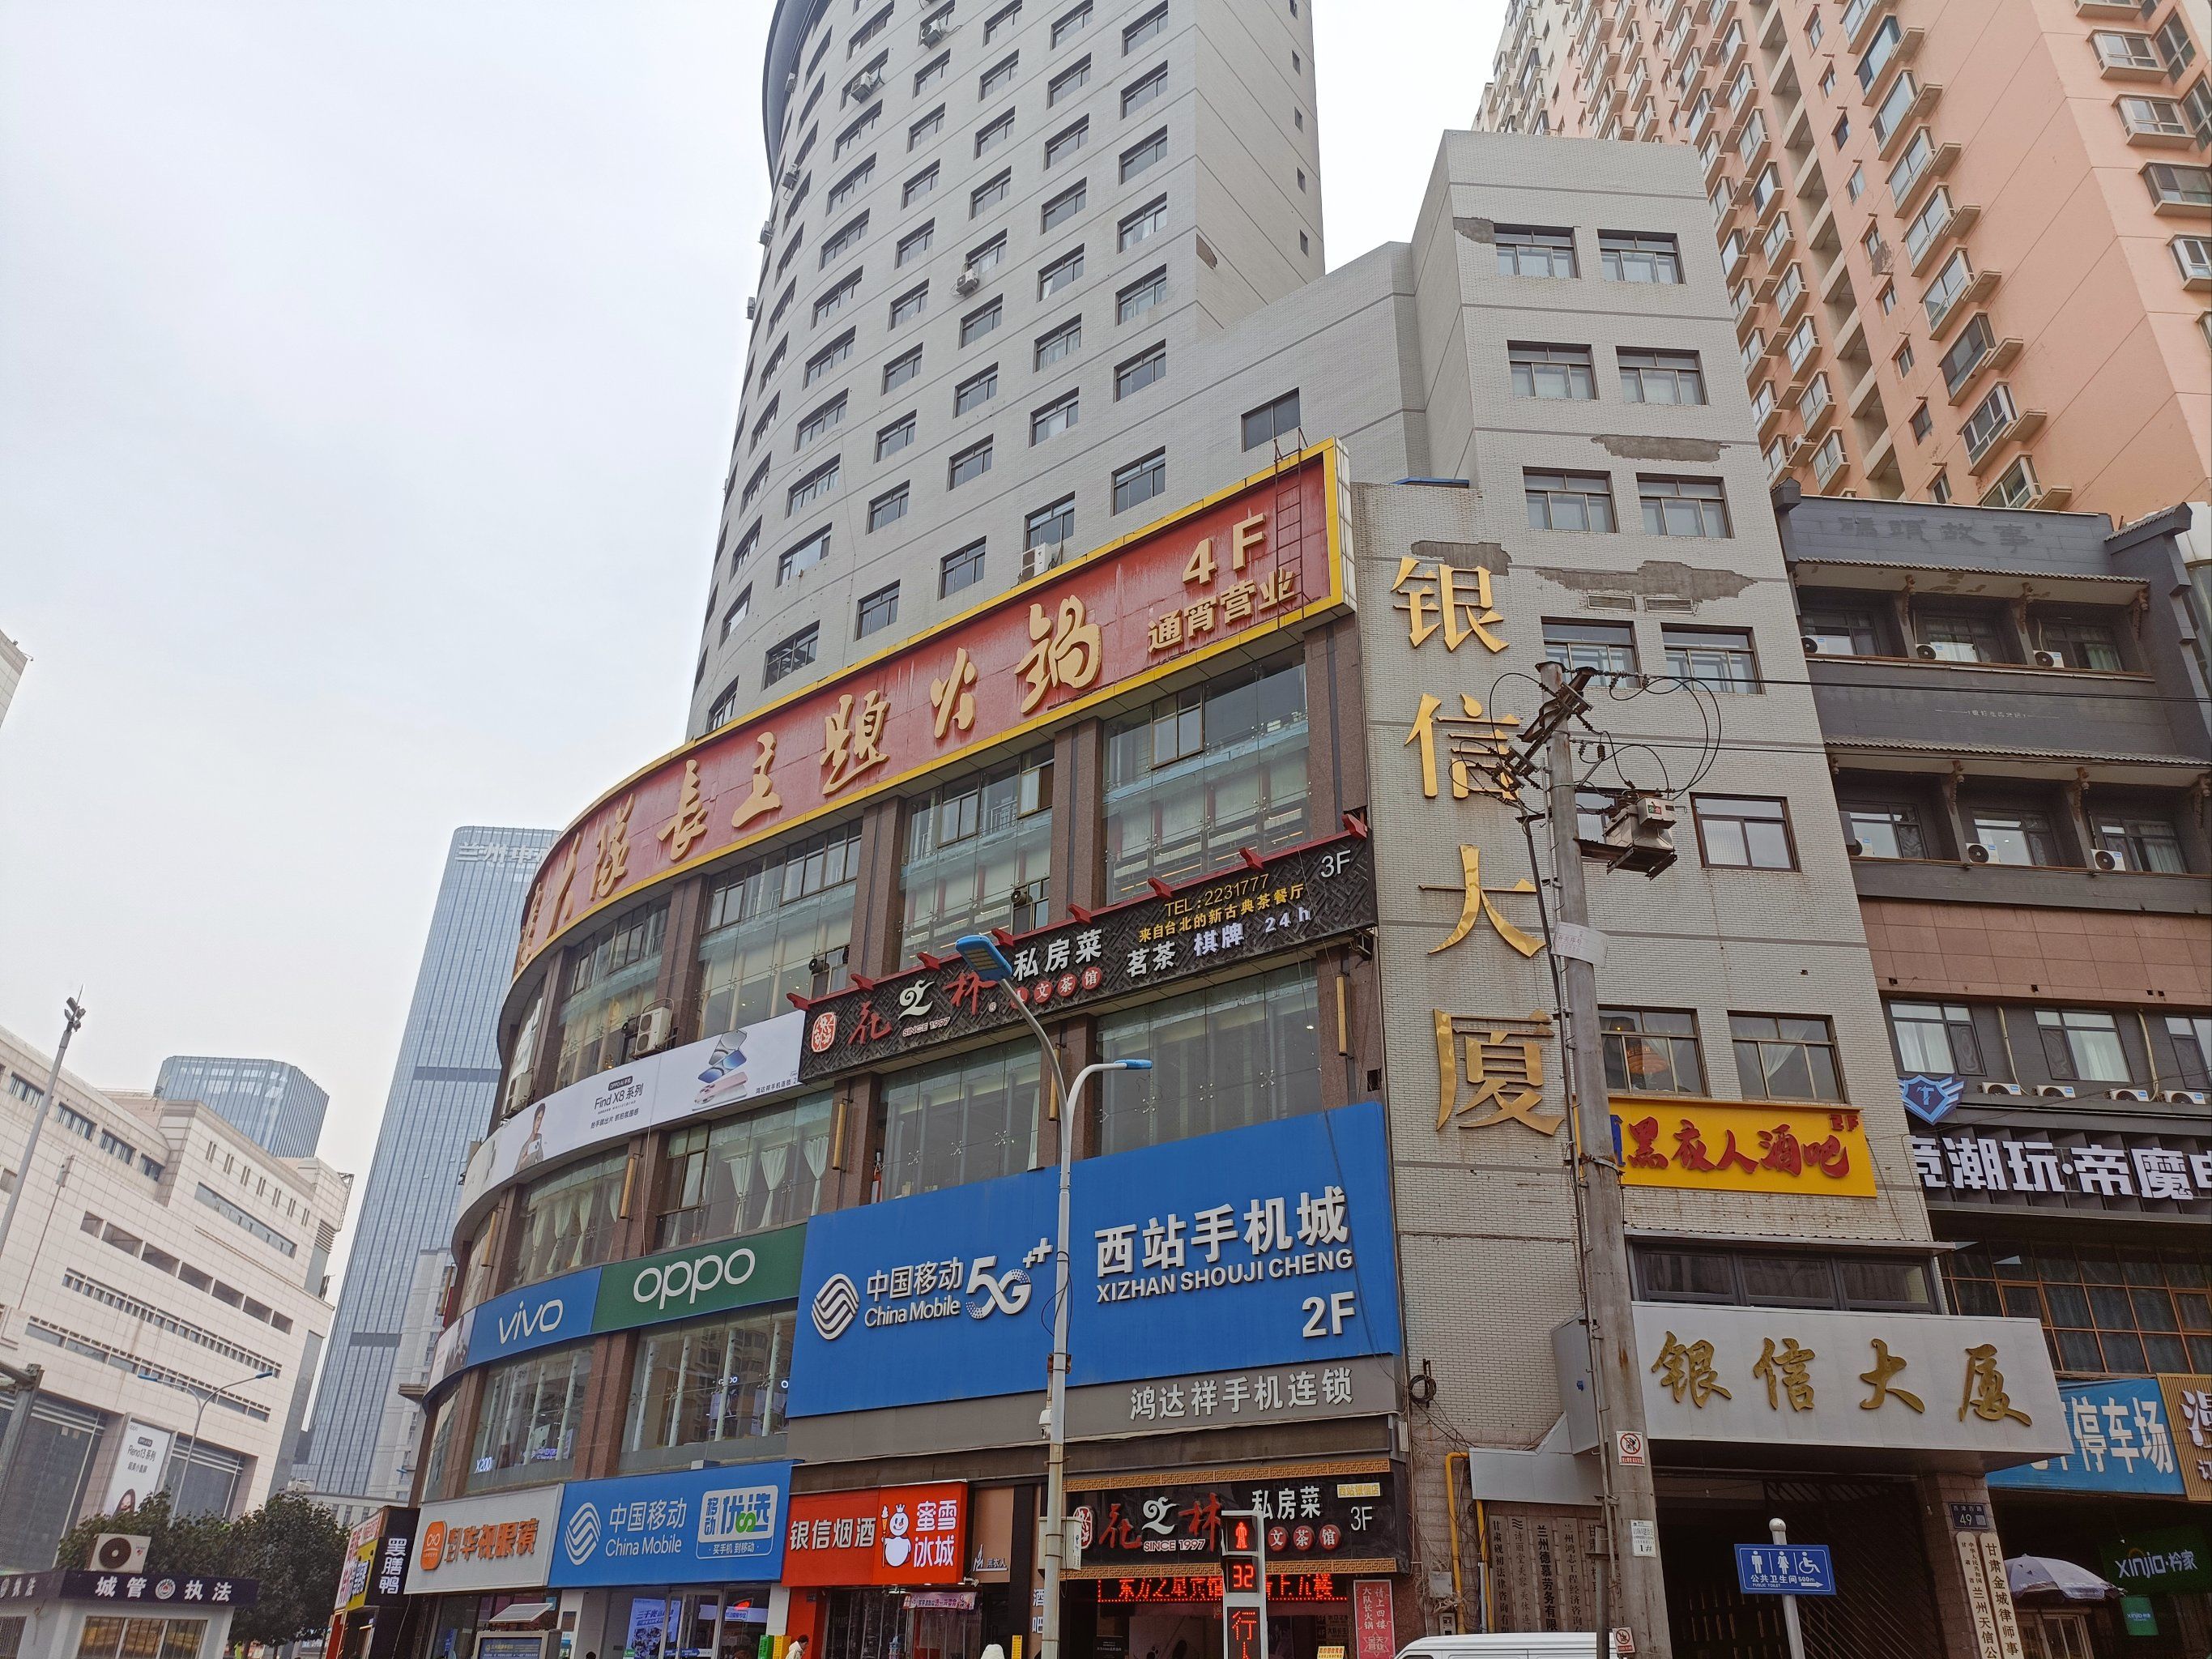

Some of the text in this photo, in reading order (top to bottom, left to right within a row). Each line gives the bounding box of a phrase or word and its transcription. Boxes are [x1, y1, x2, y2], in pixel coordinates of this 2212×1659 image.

[1182, 512, 1268, 586] 4F
[1147, 566, 1298, 655] 通宵营业
[454, 842, 550, 864] 兰州中
[1320, 849, 1352, 878] 3F
[1391, 556, 1565, 1136] 银信大厦
[1138, 883, 1305, 944] 来自台北的新古典茶餐厅
[1012, 928, 1103, 982] 私房菜
[1127, 941, 1176, 978] 茗茶
[1193, 922, 1245, 957] 棋牌
[902, 1017, 952, 1038] SINCE 1997
[595, 1094, 612, 1110] Find
[612, 1090, 625, 1104] X8
[626, 1083, 644, 1100] 系列
[1627, 1115, 1852, 1179] 黑衣人酒吧
[1094, 1186, 1350, 1278] 西站手机城
[866, 1256, 963, 1303] 中国移动
[1096, 1247, 1354, 1303] XIZHAN SHOUJI CHENG
[497, 1298, 565, 1346] vivo
[864, 1294, 961, 1328] China Mobile
[1301, 1290, 1357, 1339] 2F
[1129, 1367, 1354, 1422] 鸿达祥手机连锁
[1652, 1330, 2033, 1427] 银信大厦
[2061, 1395, 2175, 1474] 停车场
[609, 1497, 688, 1534] 中国移动
[915, 1499, 958, 1533] 蜜雪
[1251, 1485, 1323, 1521] 私房菜
[1349, 1505, 1375, 1532] 3F
[1959, 1513, 1973, 1526] 49
[605, 1533, 683, 1559] China Mobile
[790, 1516, 877, 1552] 银信烟酒
[913, 1534, 956, 1569] 冰城
[1144, 1537, 1207, 1552] SINCE 1997
[379, 1537, 407, 1594] 黑膳鸭
[1233, 1564, 1255, 1589] 32
[1750, 1574, 1797, 1584] 公共卫生间
[95, 1576, 233, 1603] 城管 执法
